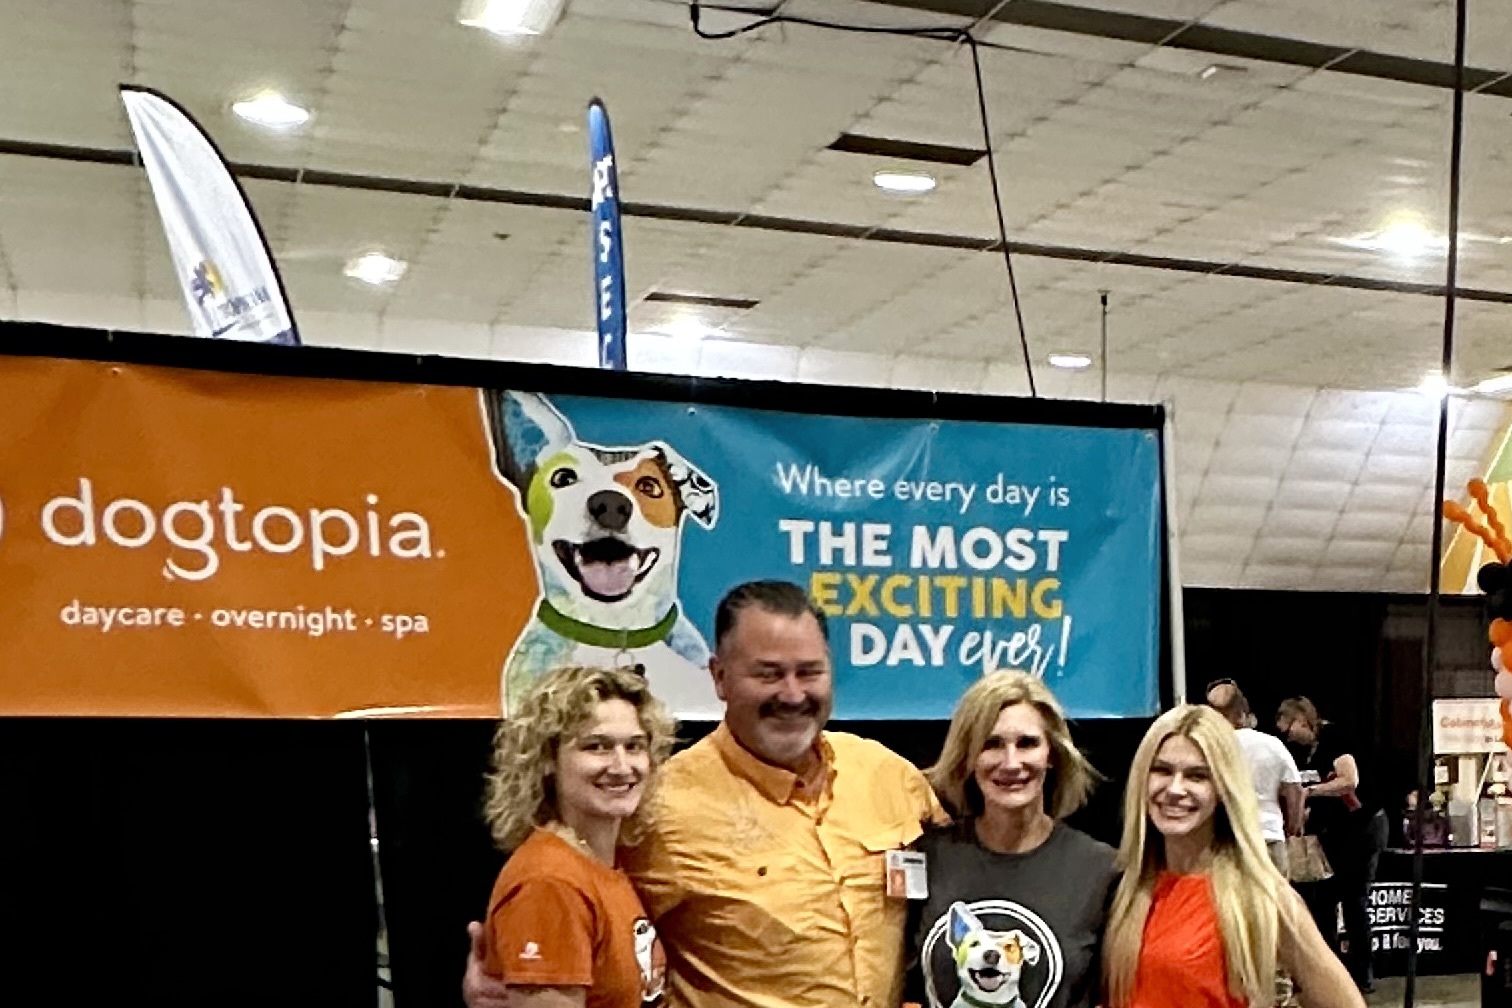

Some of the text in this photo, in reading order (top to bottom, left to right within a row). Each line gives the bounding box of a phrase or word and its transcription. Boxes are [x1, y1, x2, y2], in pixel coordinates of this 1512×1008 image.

[776, 462, 1070, 517] Where every day is
[779, 519, 1069, 572] THE MOST
[60, 599, 429, 639] daycare overnight spa
[810, 572, 1063, 619] EXCITING
[851, 615, 1072, 679] DAY ever!
